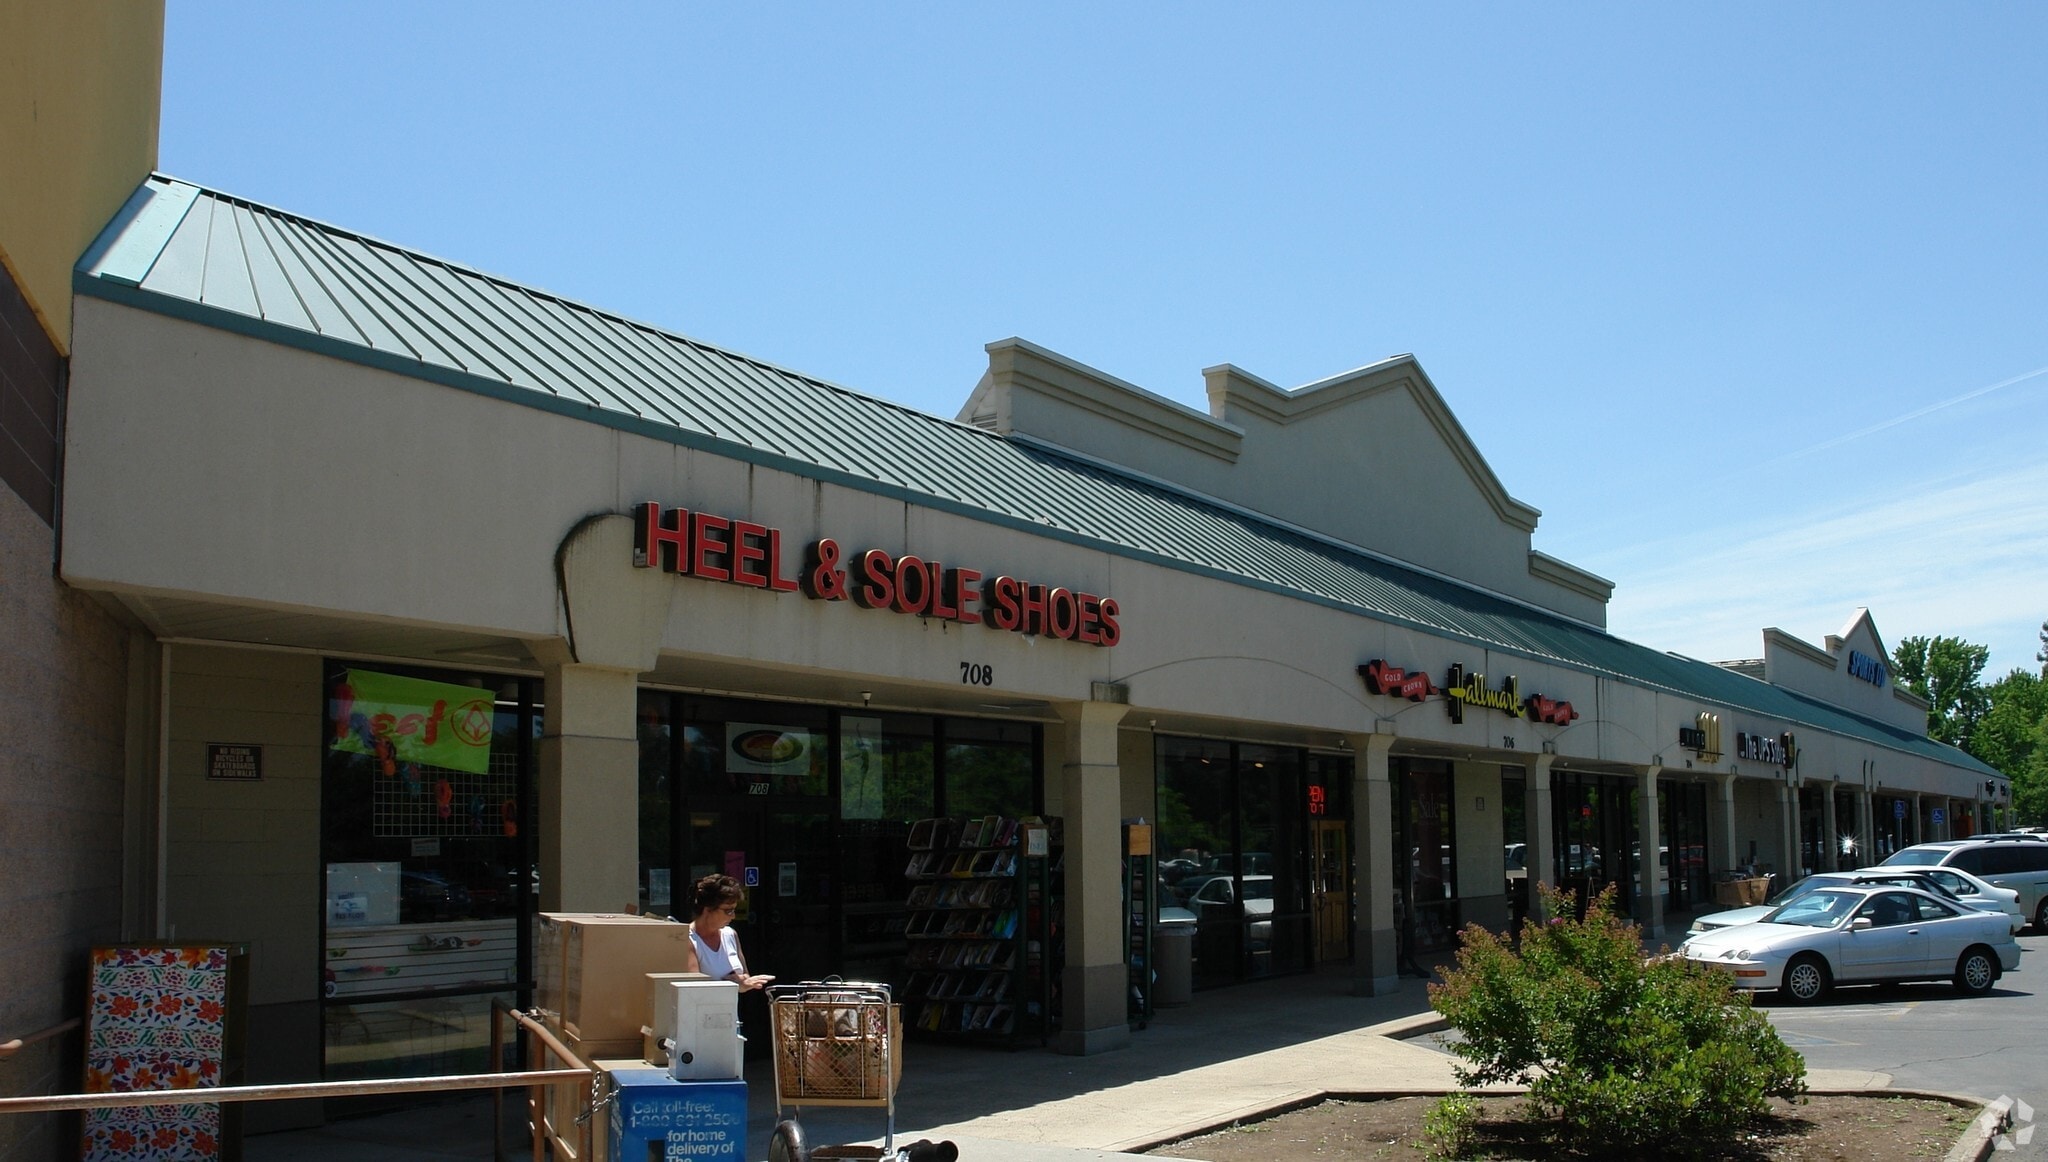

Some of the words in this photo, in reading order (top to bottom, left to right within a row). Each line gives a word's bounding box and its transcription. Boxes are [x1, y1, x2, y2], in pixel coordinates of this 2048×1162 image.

[636, 500, 799, 592] HEEL
[806, 538, 847, 600] &
[853, 549, 981, 624] SOLE
[985, 574, 1120, 648] SHOES
[961, 662, 993, 686] 708
[1384, 673, 1402, 682] GOLD
[1403, 681, 1423, 693] CROWN
[1448, 662, 1527, 724] Hallmark
[1503, 736, 1515, 749] 706
[1744, 733, 1757, 760] The
[751, 783, 768, 793] 708
[633, 1101, 658, 1114] Call
[667, 1130, 687, 1142] for
[688, 1129, 727, 1142] home
[667, 1142, 719, 1157] delivery
[720, 1141, 735, 1153] of
